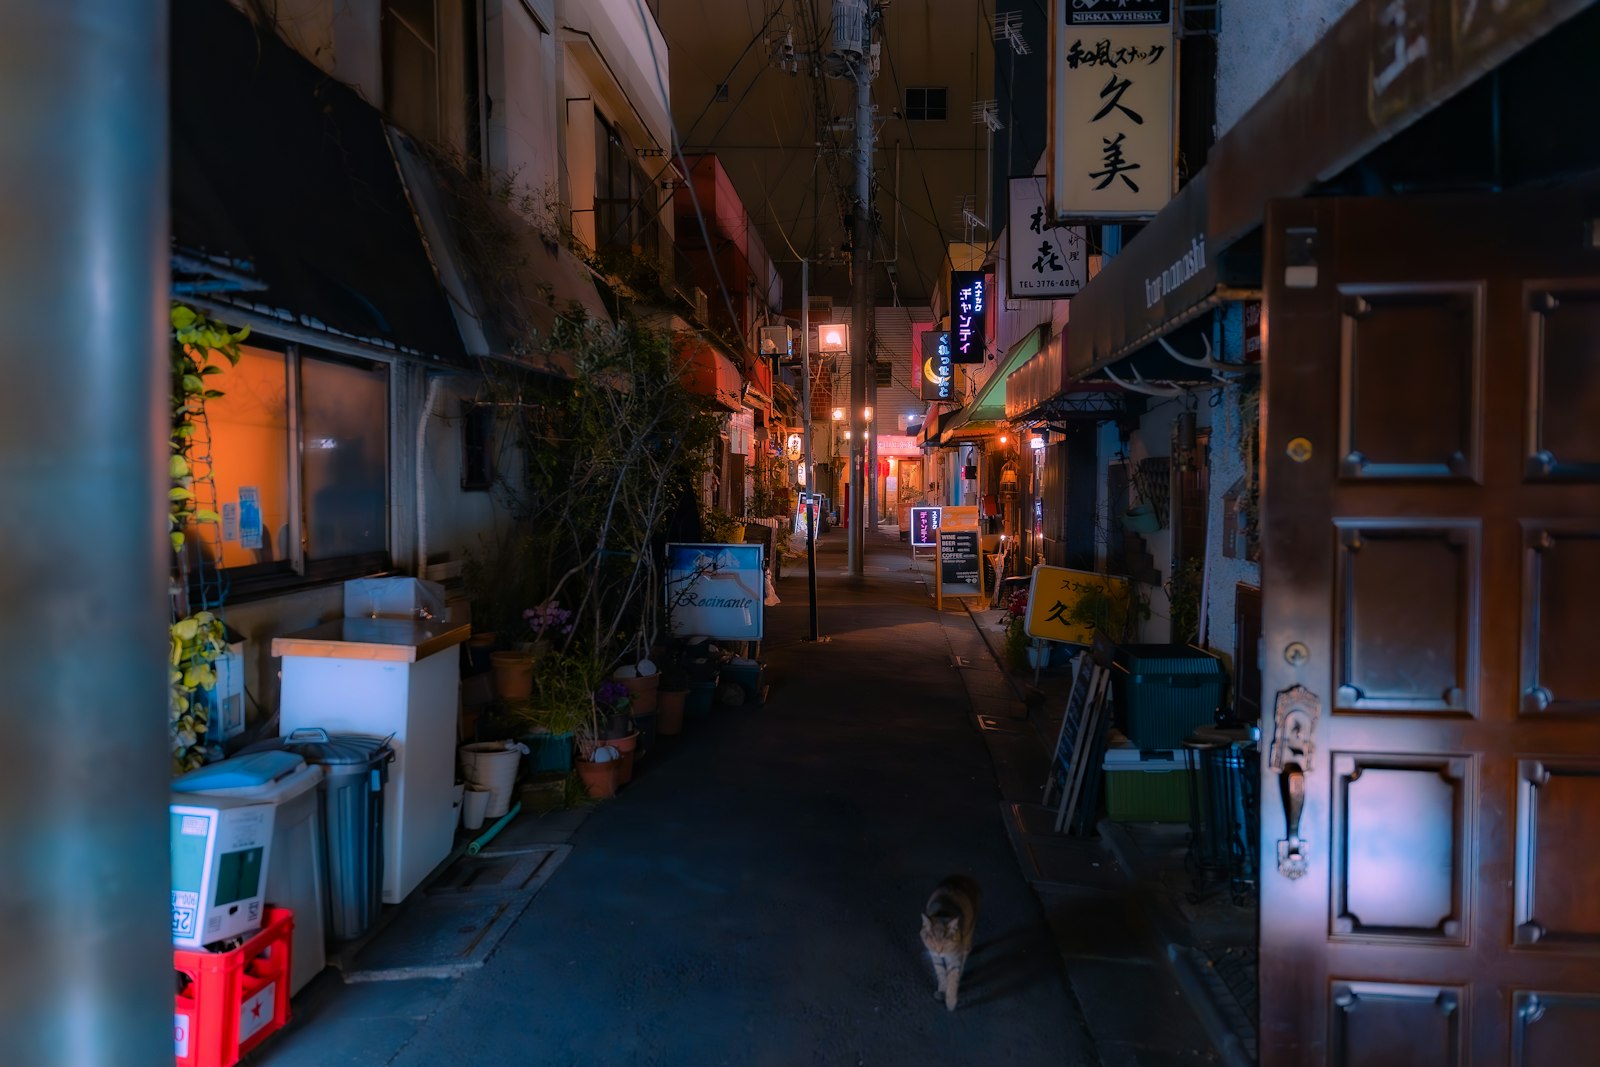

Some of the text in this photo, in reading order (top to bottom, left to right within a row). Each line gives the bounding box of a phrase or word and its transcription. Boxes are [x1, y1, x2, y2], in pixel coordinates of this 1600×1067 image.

[1072, 11, 1161, 21] NIKKA WHISKY
[1089, 73, 1144, 193] 久美
[1019, 281, 1034, 289] TEL
[974, 281, 983, 312] スナック
[677, 592, 752, 609] Rocinante
